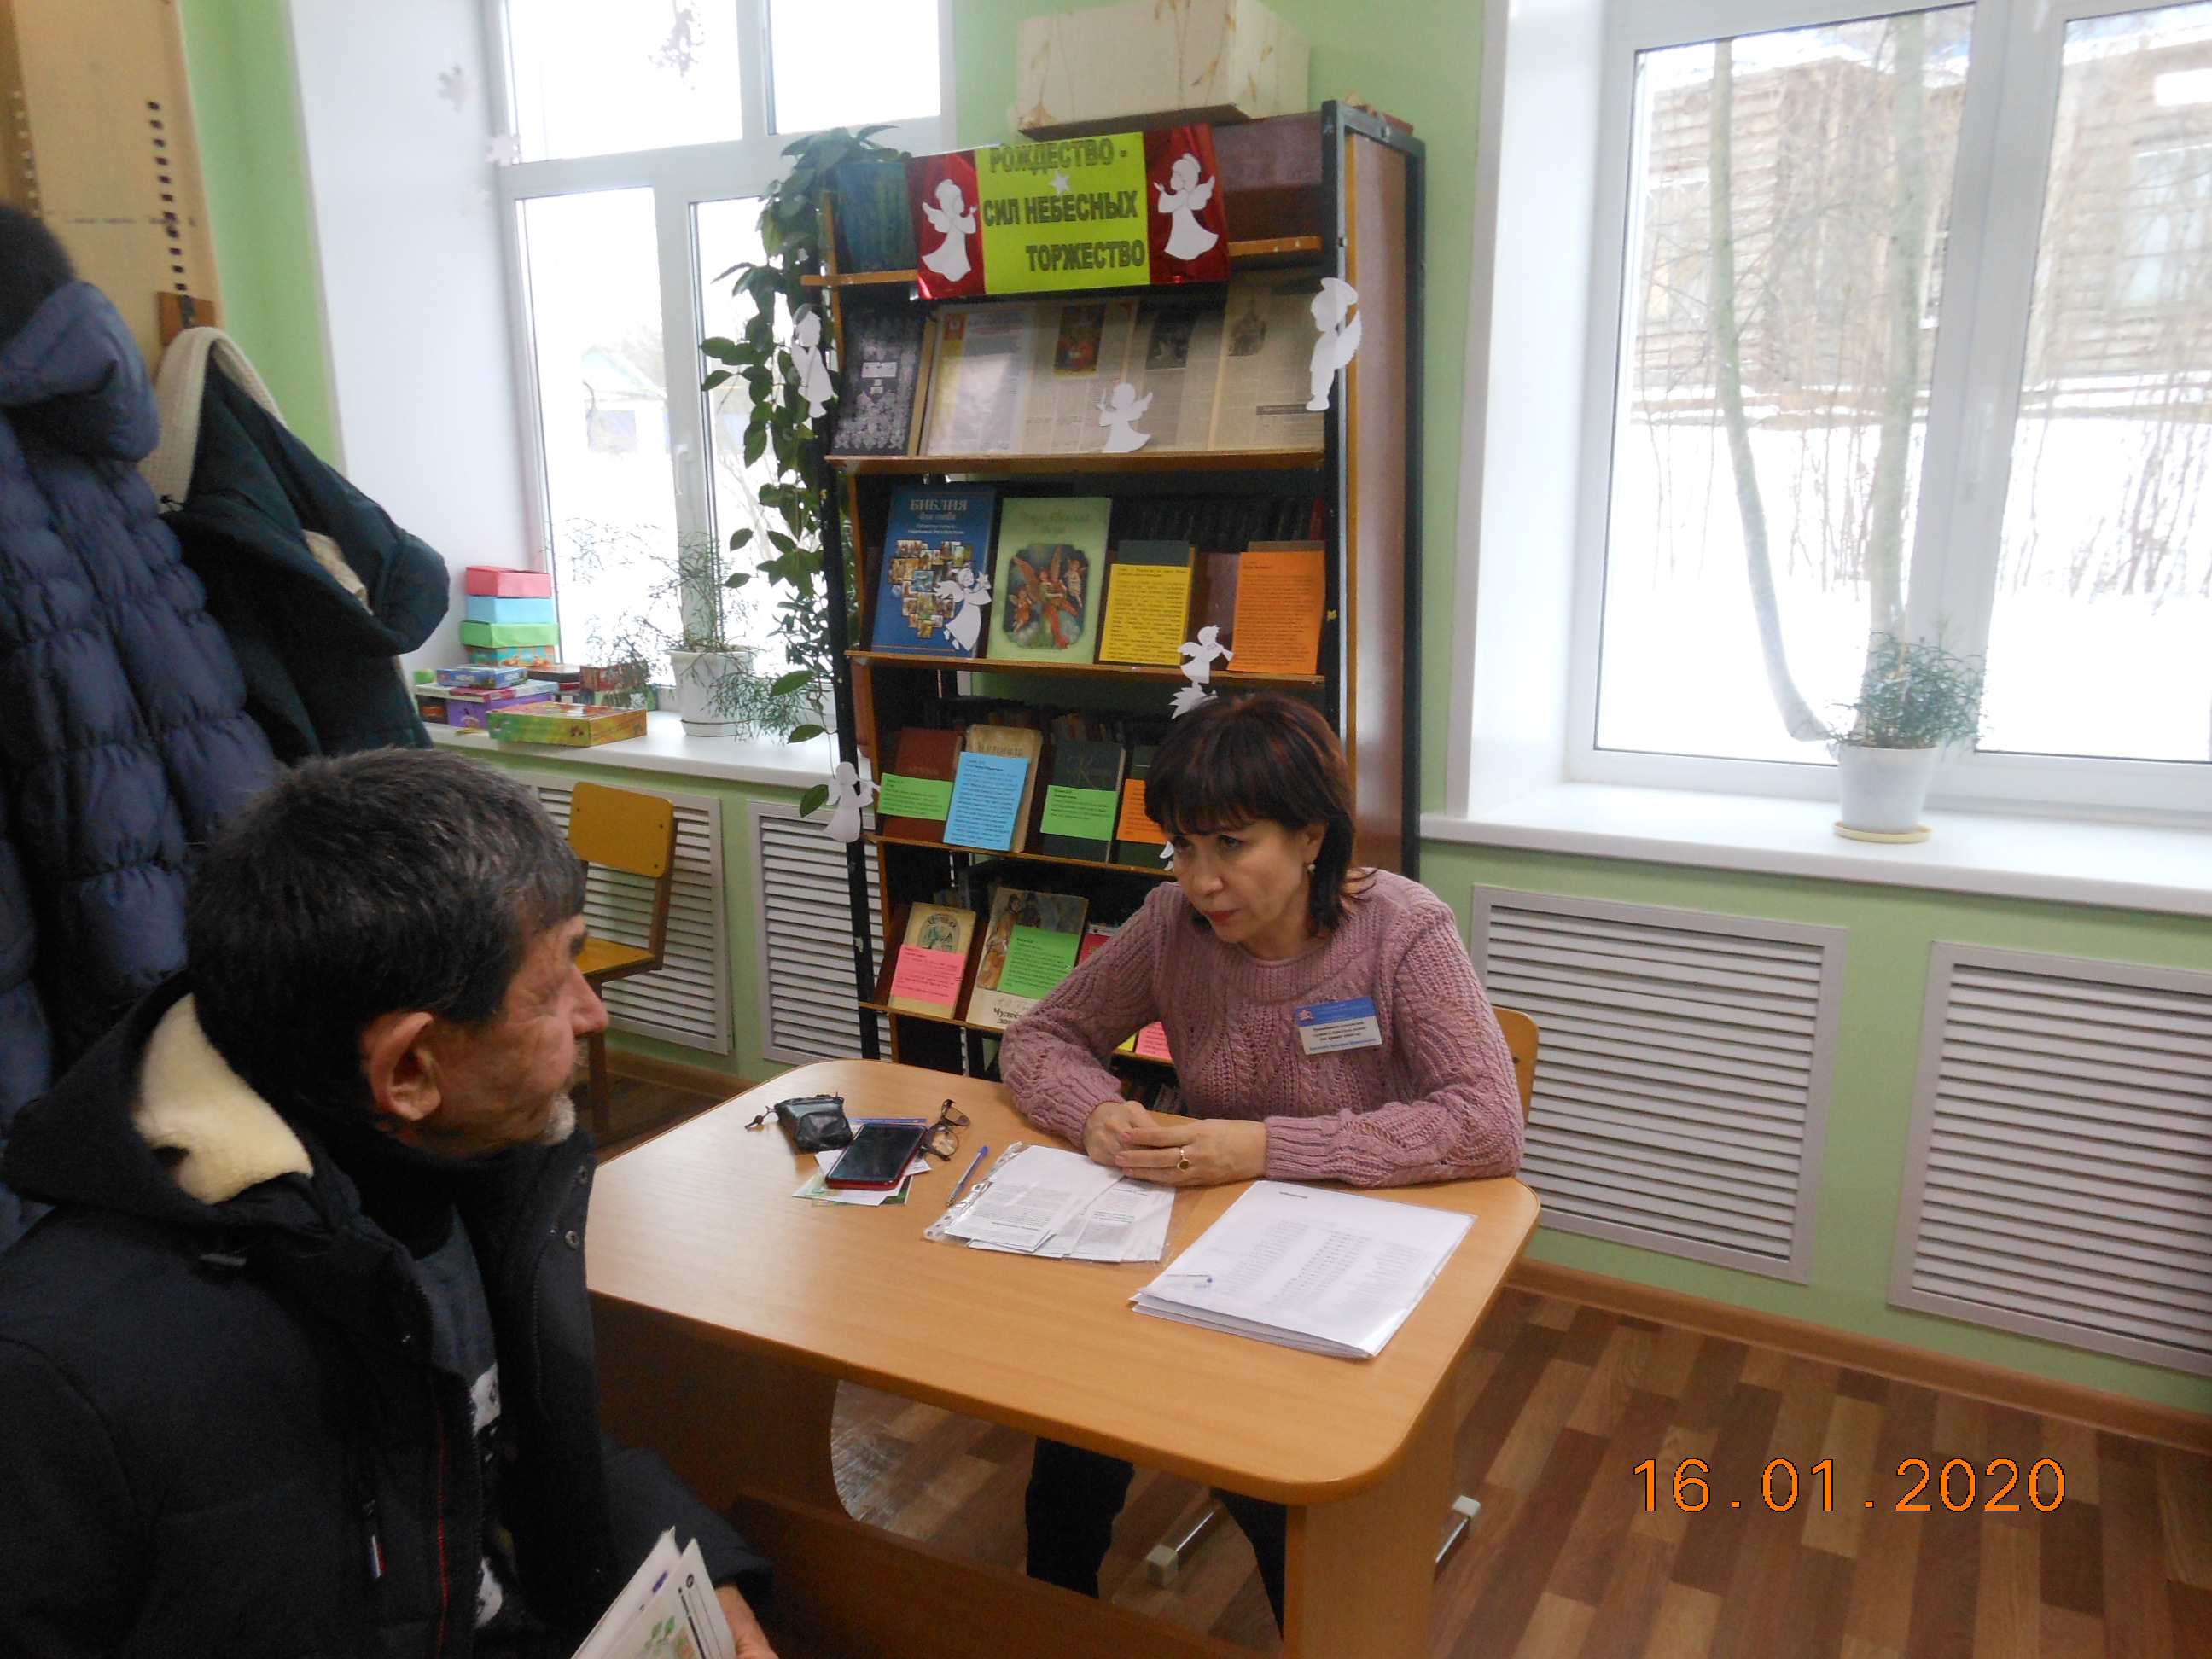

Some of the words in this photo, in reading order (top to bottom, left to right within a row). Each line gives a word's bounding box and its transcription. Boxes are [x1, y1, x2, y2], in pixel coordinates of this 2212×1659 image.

[989, 138, 1115, 175] РОЖДЕСТВО
[983, 198, 1021, 227] СИЛ
[1025, 190, 1138, 224] НЕБЕСНЫХ
[1026, 240, 1145, 272] ТОРЖЕСТВО
[910, 499, 969, 511] БИБЛИЯ
[993, 1007, 1022, 1019] Чудес
